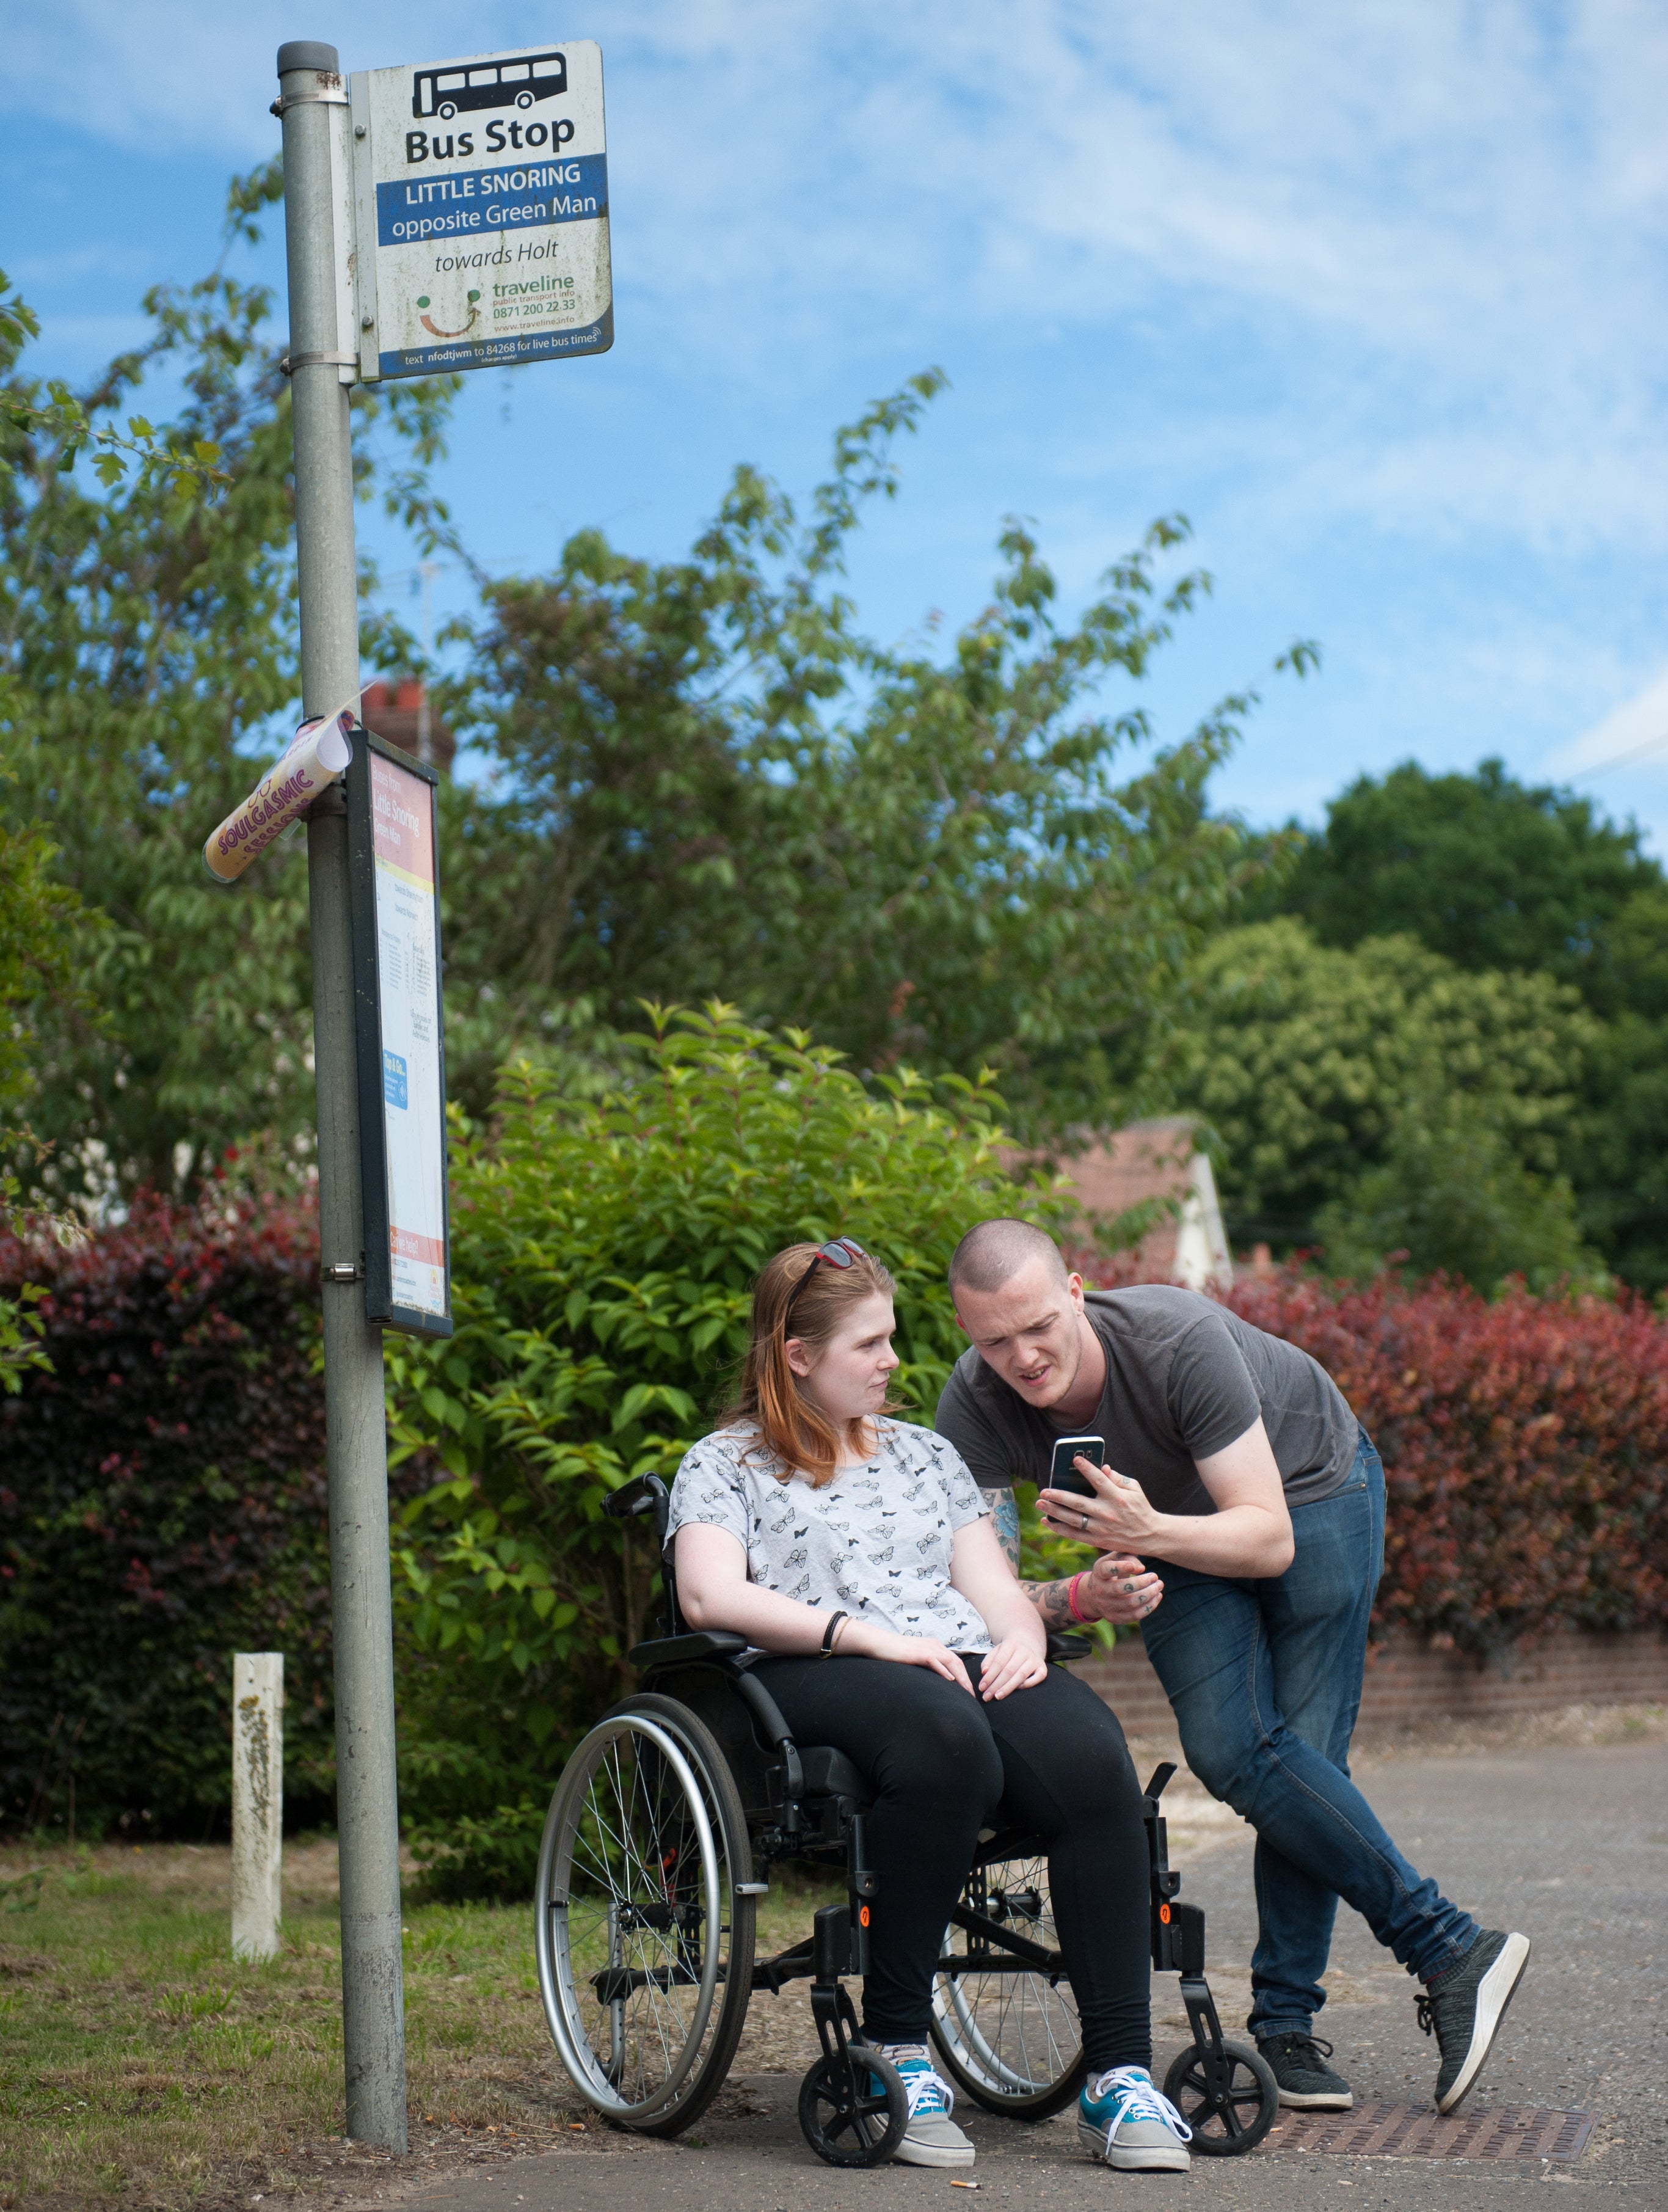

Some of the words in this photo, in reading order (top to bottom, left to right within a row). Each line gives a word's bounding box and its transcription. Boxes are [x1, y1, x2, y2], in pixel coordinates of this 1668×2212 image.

[406, 131, 474, 164] Bus
[486, 119, 575, 153] Stop
[406, 178, 475, 205] LITTLE
[481, 163, 581, 195] SNORING
[392, 210, 481, 239] opposite
[486, 204, 547, 225] Green
[553, 195, 597, 216] Man
[435, 245, 512, 272] towards
[518, 239, 559, 262] Holt
[492, 275, 574, 297] traveline
[493, 297, 517, 307] public
[520, 292, 556, 302] transport
[559, 289, 575, 297] info
[493, 306, 519, 319] 0871
[523, 303, 543, 315] 200
[494, 316, 575, 332] www.traveline.info
[405, 354, 424, 365] text
[428, 349, 472, 362] nfodtjwm
[475, 348, 484, 357] to
[486, 342, 515, 355] 84268
[517, 341, 531, 351] for
[533, 339, 549, 349] live
[552, 337, 569, 347] bus
[571, 334, 597, 345] times
[373, 764, 388, 787] Buses
[388, 773, 401, 794] from
[218, 769, 313, 855] SOULGASMIC
[374, 789, 391, 817] Little
[392, 800, 420, 838] Snoring
[374, 817, 389, 839] Green
[390, 826, 401, 845] Man
